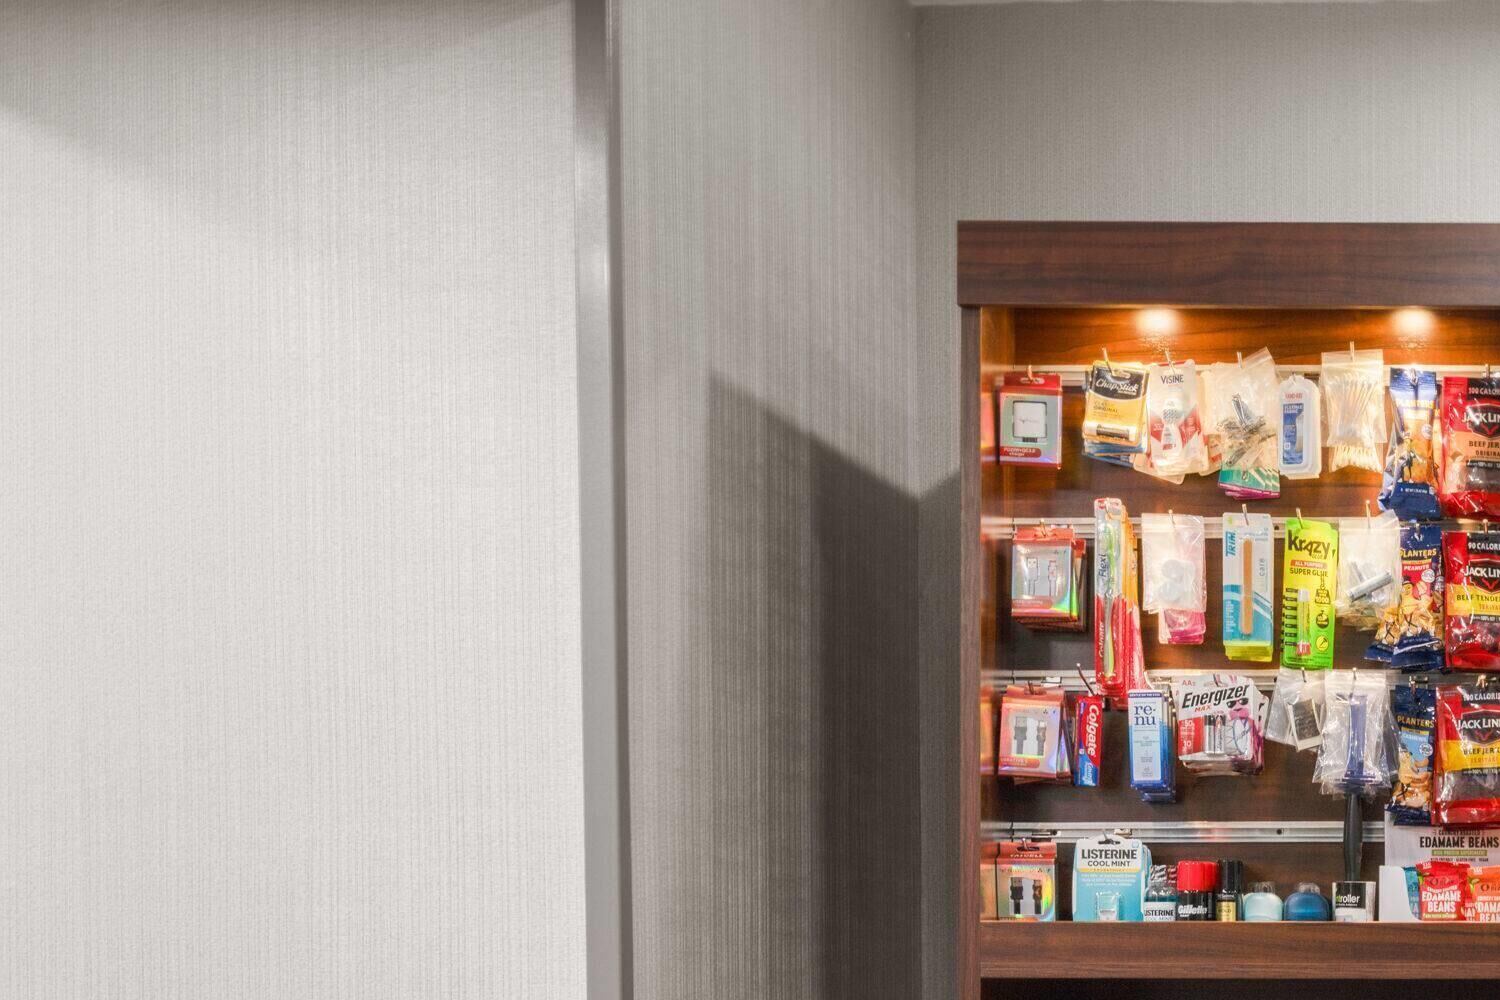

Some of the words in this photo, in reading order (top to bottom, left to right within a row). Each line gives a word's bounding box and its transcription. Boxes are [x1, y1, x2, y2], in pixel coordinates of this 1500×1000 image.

[1400, 549, 1437, 557] PLANTERS
[1289, 568, 1311, 576] SUPER
[1312, 568, 1329, 577] GLUE
[1464, 566, 1487, 577] JACK
[1182, 684, 1250, 709] Energizer
[1134, 715, 1156, 726] nu
[1397, 715, 1435, 728] PLANTERS
[1457, 718, 1481, 730] JACK
[1086, 704, 1100, 757] Colgate
[1420, 836, 1465, 848] EDAMAME
[1468, 836, 1500, 848] BEANS
[1081, 849, 1137, 860] LISTERINE
[1422, 891, 1461, 902] EDAMAME
[1428, 902, 1456, 913] BEANS
